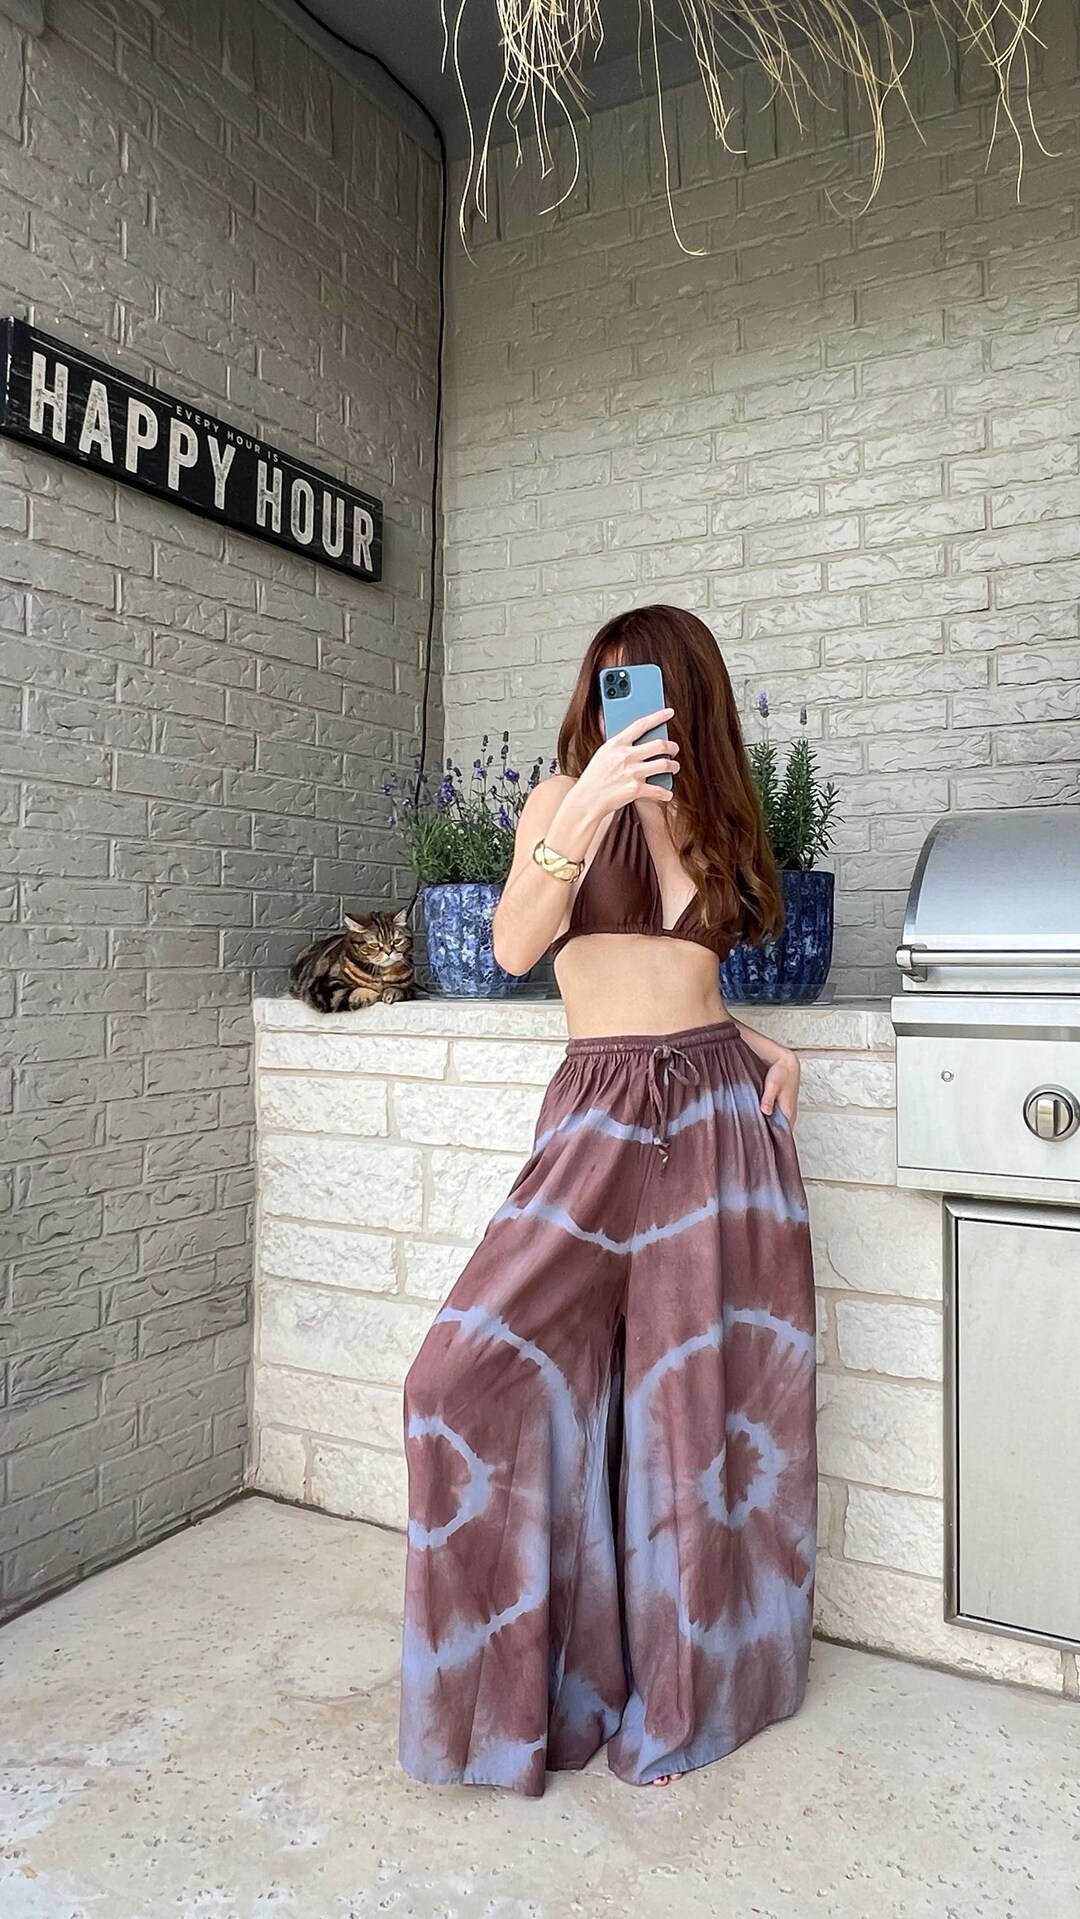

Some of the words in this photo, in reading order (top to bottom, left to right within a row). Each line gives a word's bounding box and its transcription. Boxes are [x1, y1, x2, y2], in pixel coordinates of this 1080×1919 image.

[29, 351, 236, 510] HAPPY
[255, 459, 374, 572] HOUR
[176, 405, 220, 433] EVERY
[227, 431, 261, 455] HOUR
[267, 451, 279, 463] IS
